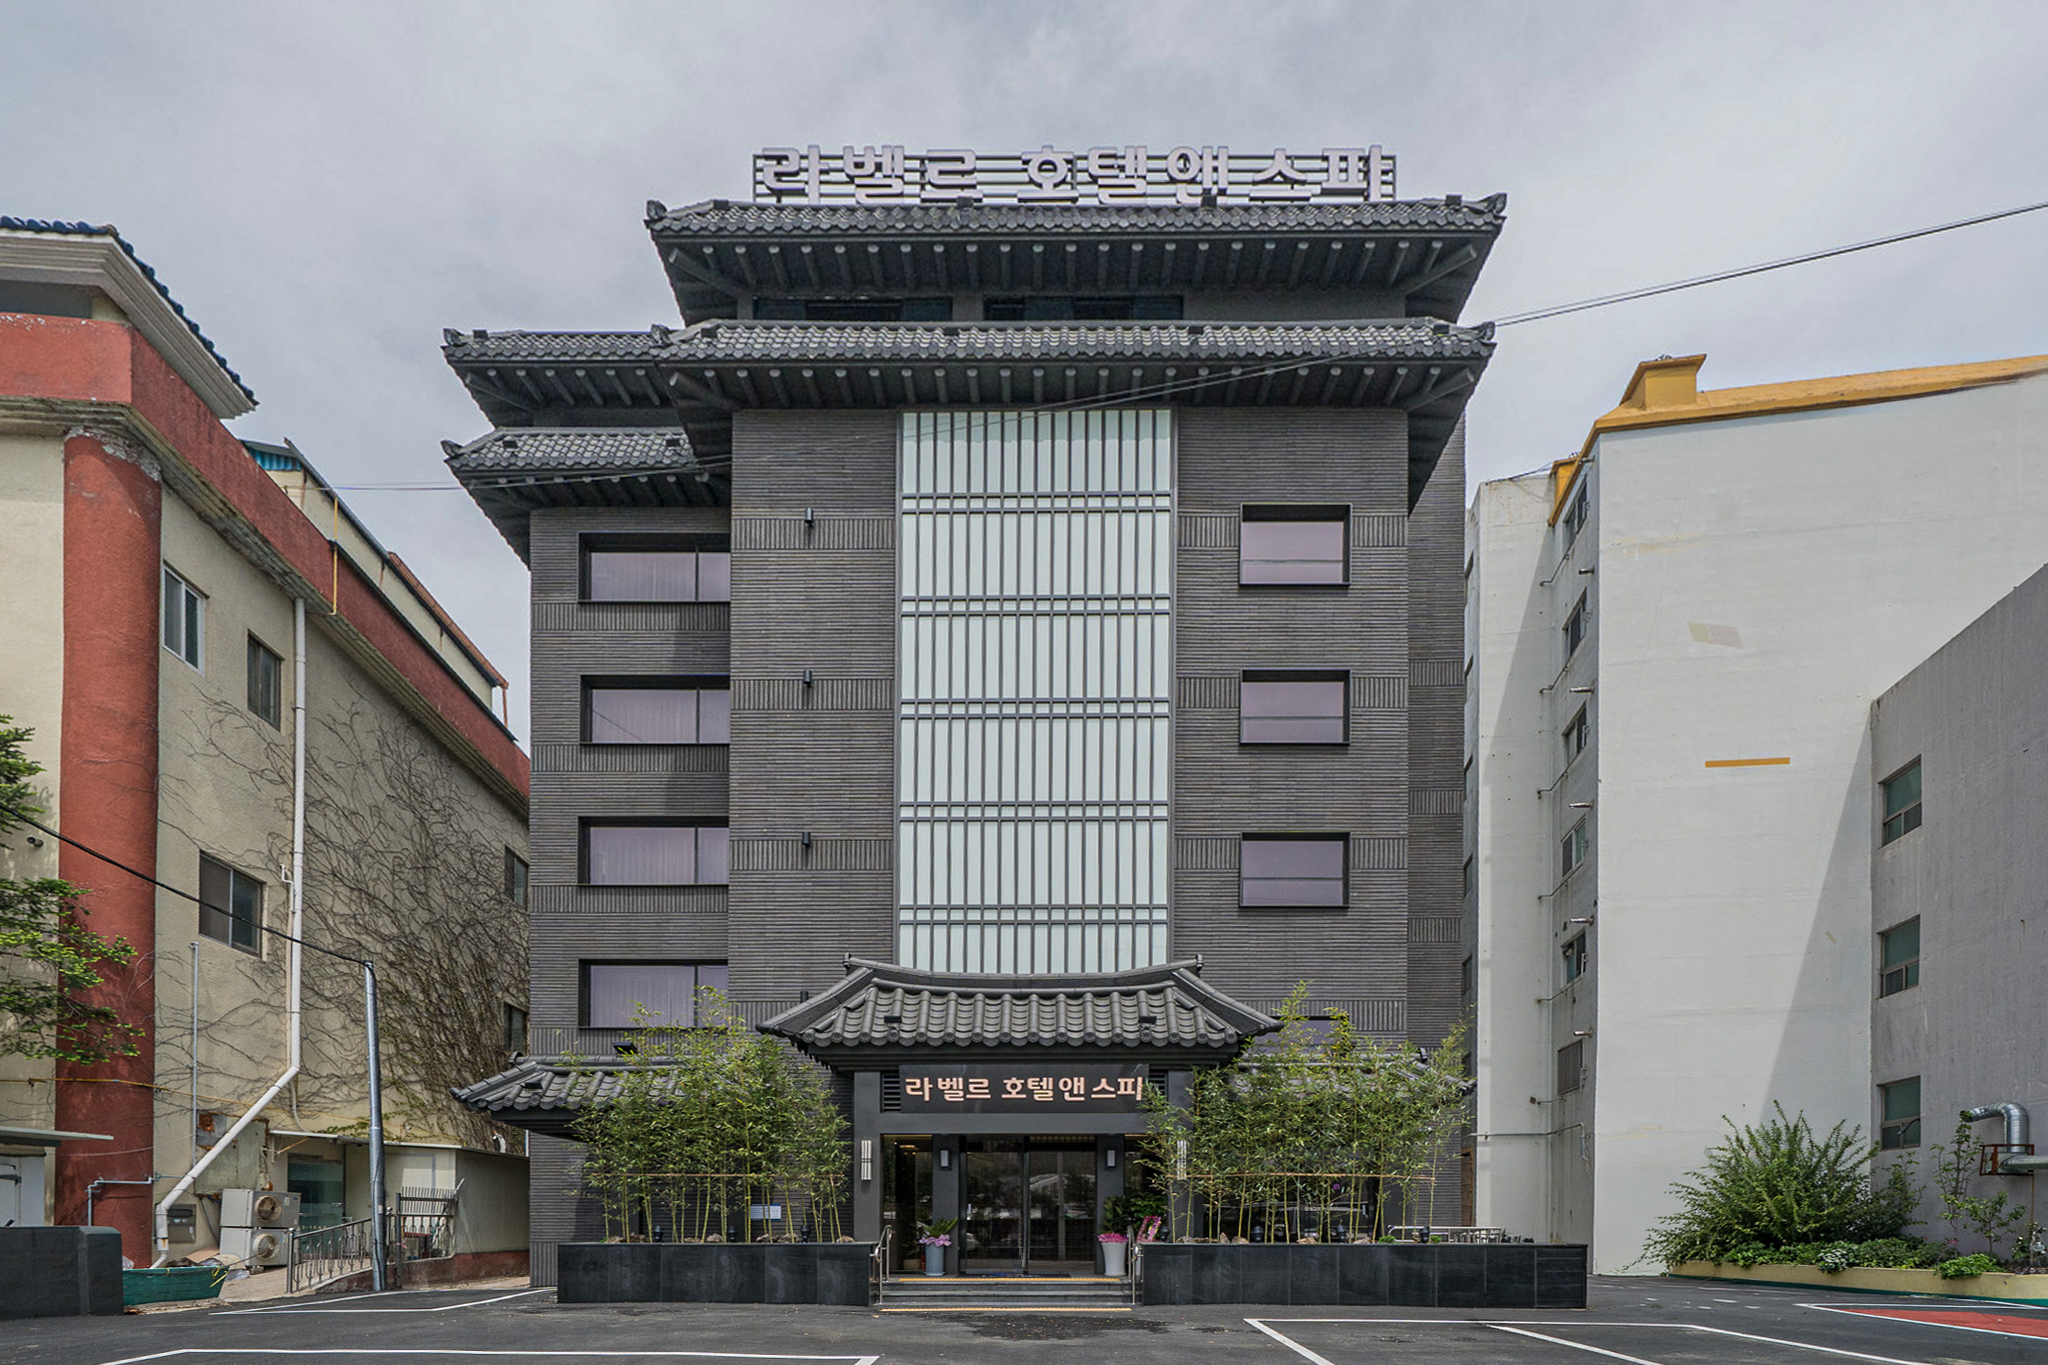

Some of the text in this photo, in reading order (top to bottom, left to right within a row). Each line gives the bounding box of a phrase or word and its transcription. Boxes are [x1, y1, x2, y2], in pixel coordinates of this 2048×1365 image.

[762, 144, 1392, 204] 라벨르 호텔앤스파
[905, 1077, 991, 1102] 라벨르
